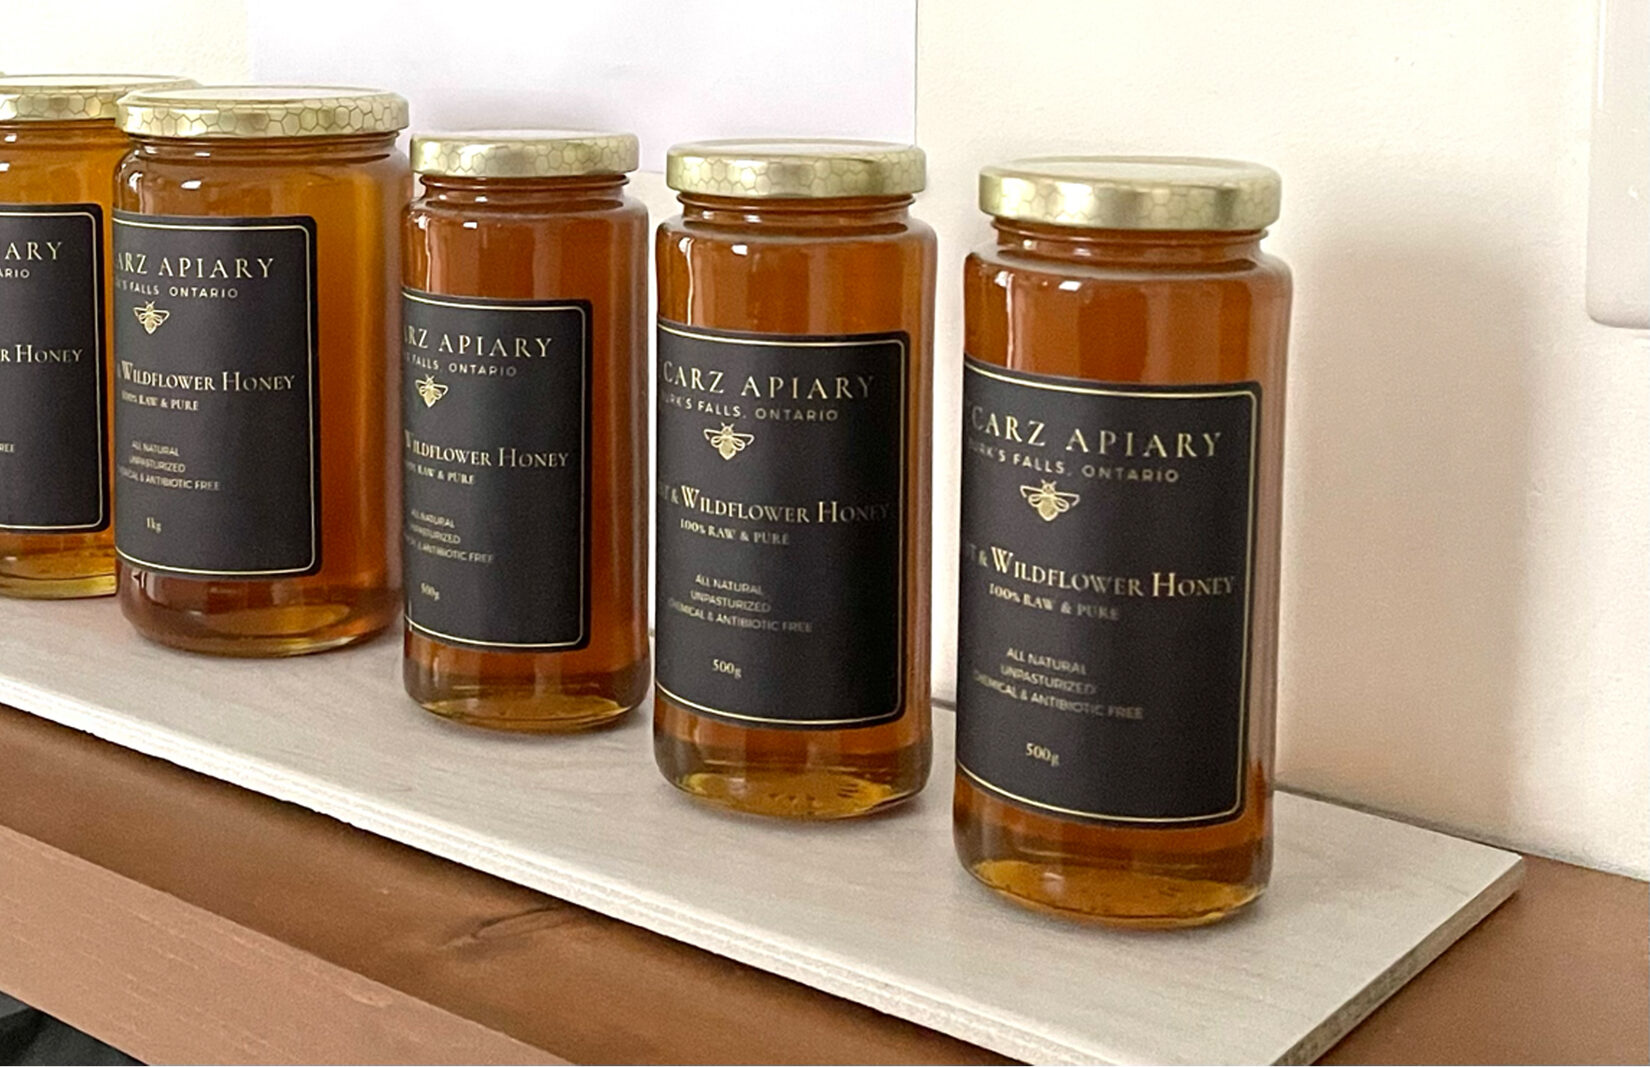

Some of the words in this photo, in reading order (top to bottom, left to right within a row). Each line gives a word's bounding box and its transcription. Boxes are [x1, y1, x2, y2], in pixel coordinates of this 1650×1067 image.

[158, 257, 274, 278] APIARY
[169, 286, 238, 298] ONTARIO
[15, 344, 82, 363] HONEY
[438, 334, 552, 358] APIARY
[121, 360, 215, 391] WILDFLOWER
[222, 371, 295, 391] HONEY
[448, 362, 517, 377] ONTARIO
[741, 376, 874, 400] APIARY
[171, 399, 199, 411] PURE
[755, 407, 838, 422] ONTARIO
[1065, 428, 1222, 458] APIARY
[498, 447, 569, 468] HONEY
[1081, 464, 1180, 483] ONTARIO
[681, 485, 810, 523] WILDFLOWER
[818, 501, 890, 524] HONEY
[146, 517, 162, 534] 1kg
[708, 525, 735, 540] RAW
[740, 531, 749, 542] &
[753, 533, 790, 546] PURE
[990, 546, 1145, 597] WILDFLOWER
[1151, 572, 1235, 598] HONEY
[695, 574, 710, 587] ALL
[713, 579, 764, 596] NATURAL
[1023, 593, 1053, 611] RAW
[1060, 601, 1072, 614] &
[1077, 605, 1119, 621] PURE
[716, 613, 779, 632] ANTIBIOTIC
[782, 621, 813, 633] FREE
[712, 659, 742, 679] 500g
[1006, 647, 1025, 663] ALL
[1028, 653, 1086, 676] NATURAL
[1030, 692, 1104, 717] ANTIBIOTIC
[1108, 705, 1144, 720] FREE
[1025, 742, 1060, 767] 500g
